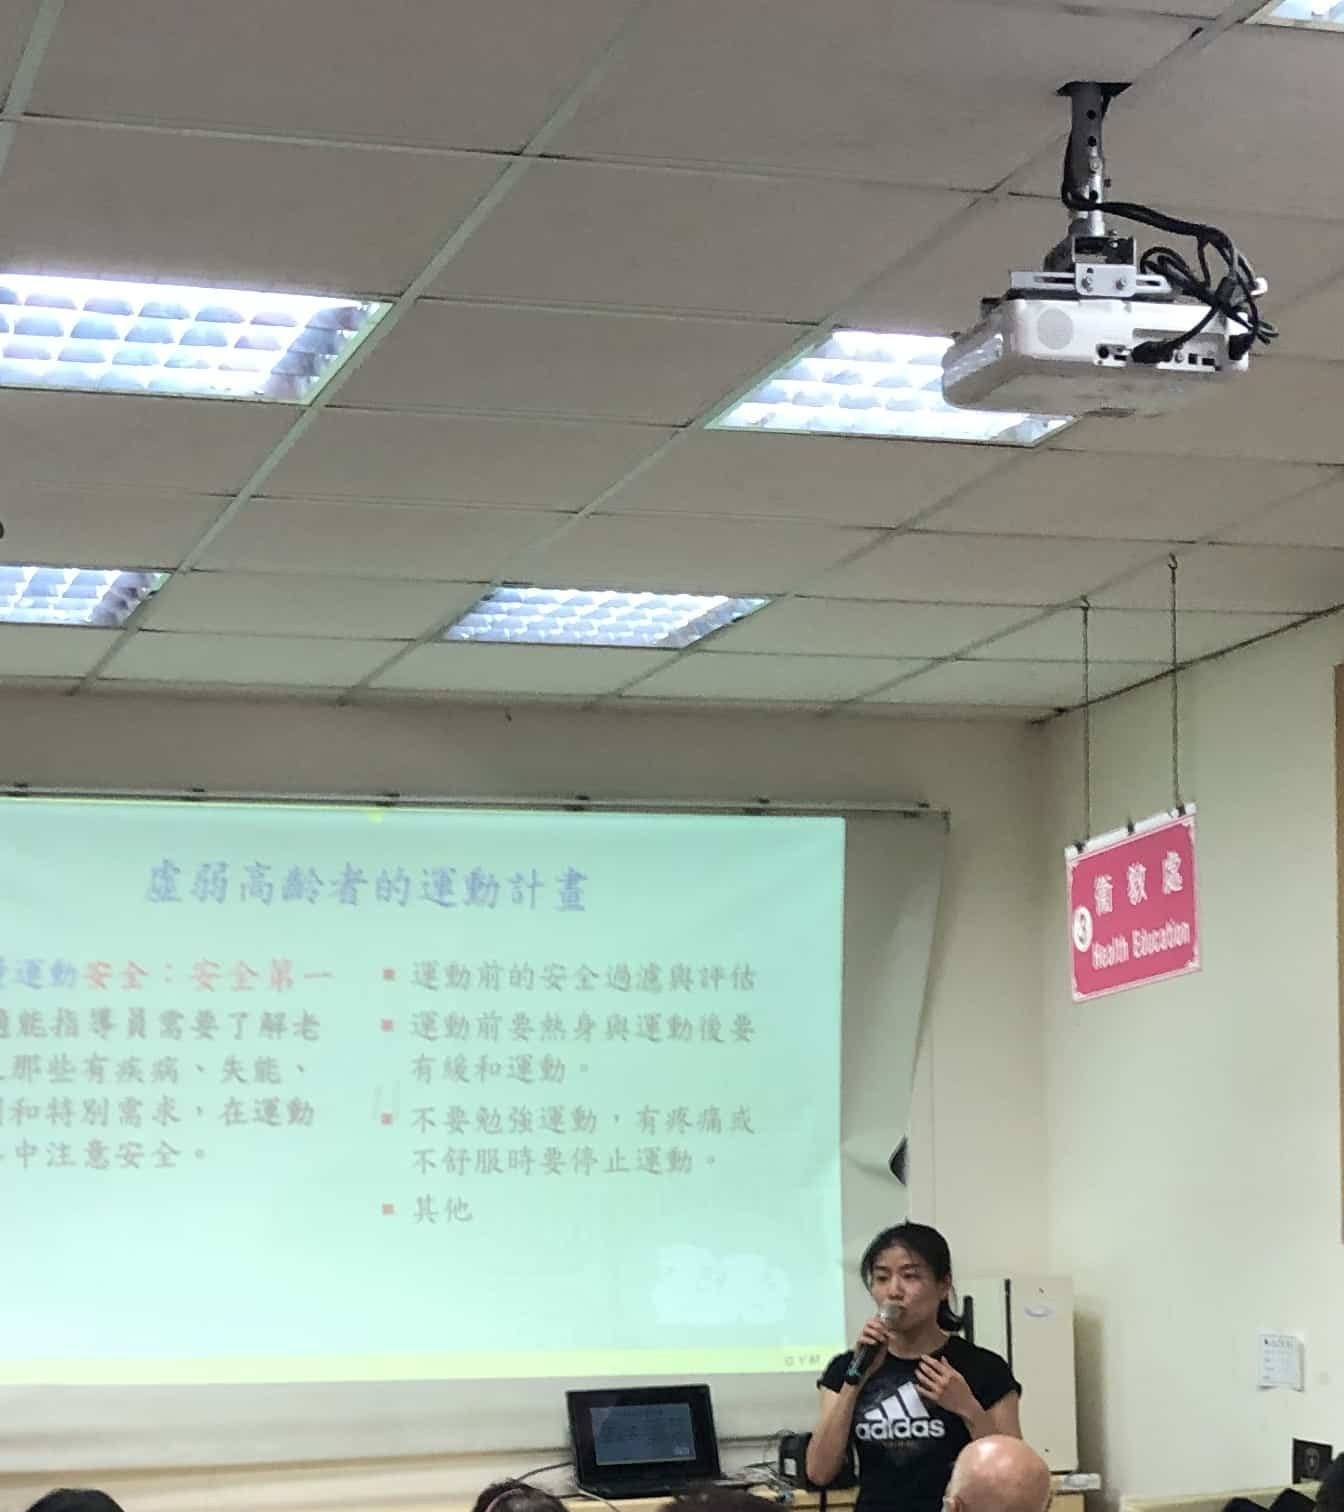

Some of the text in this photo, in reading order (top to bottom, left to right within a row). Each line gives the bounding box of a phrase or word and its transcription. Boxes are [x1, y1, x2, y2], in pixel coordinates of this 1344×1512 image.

[1091, 935, 1130, 971] Health
[411, 1194, 474, 1225] 其他
[855, 1417, 946, 1441] adidas
